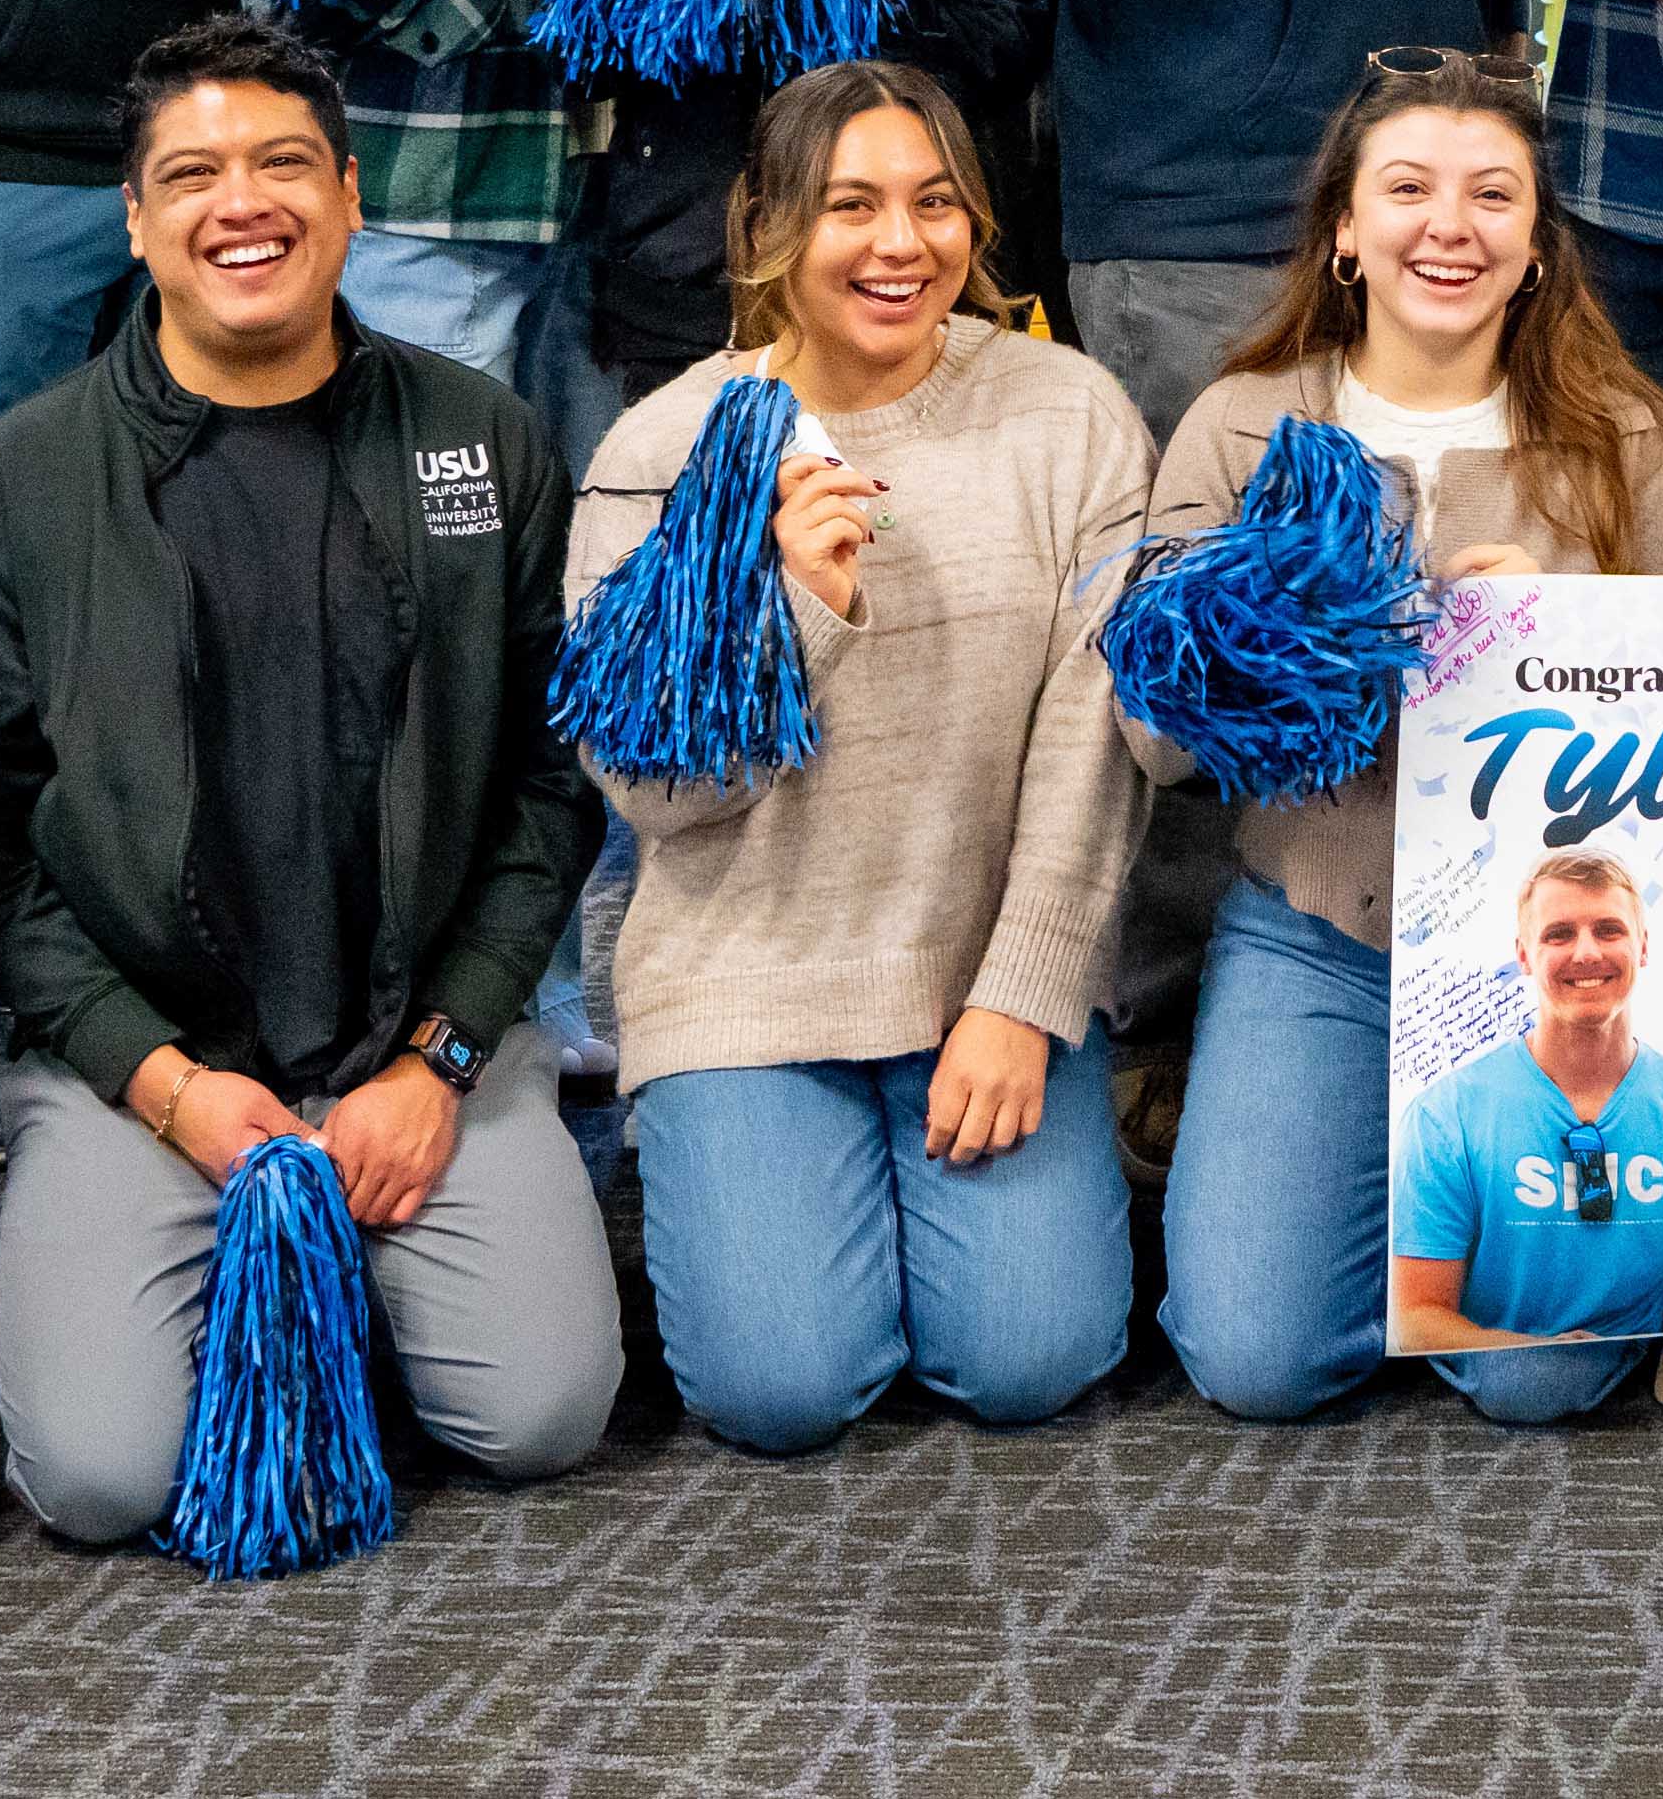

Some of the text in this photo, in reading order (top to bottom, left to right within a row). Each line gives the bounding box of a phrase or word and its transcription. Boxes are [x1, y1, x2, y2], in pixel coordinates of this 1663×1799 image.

[415, 443, 490, 483] USU
[419, 479, 495, 497] CALIFORNIA
[421, 492, 497, 511] STATE
[424, 505, 498, 523] UNIVERSITY
[427, 518, 503, 537] SAN MARCOS
